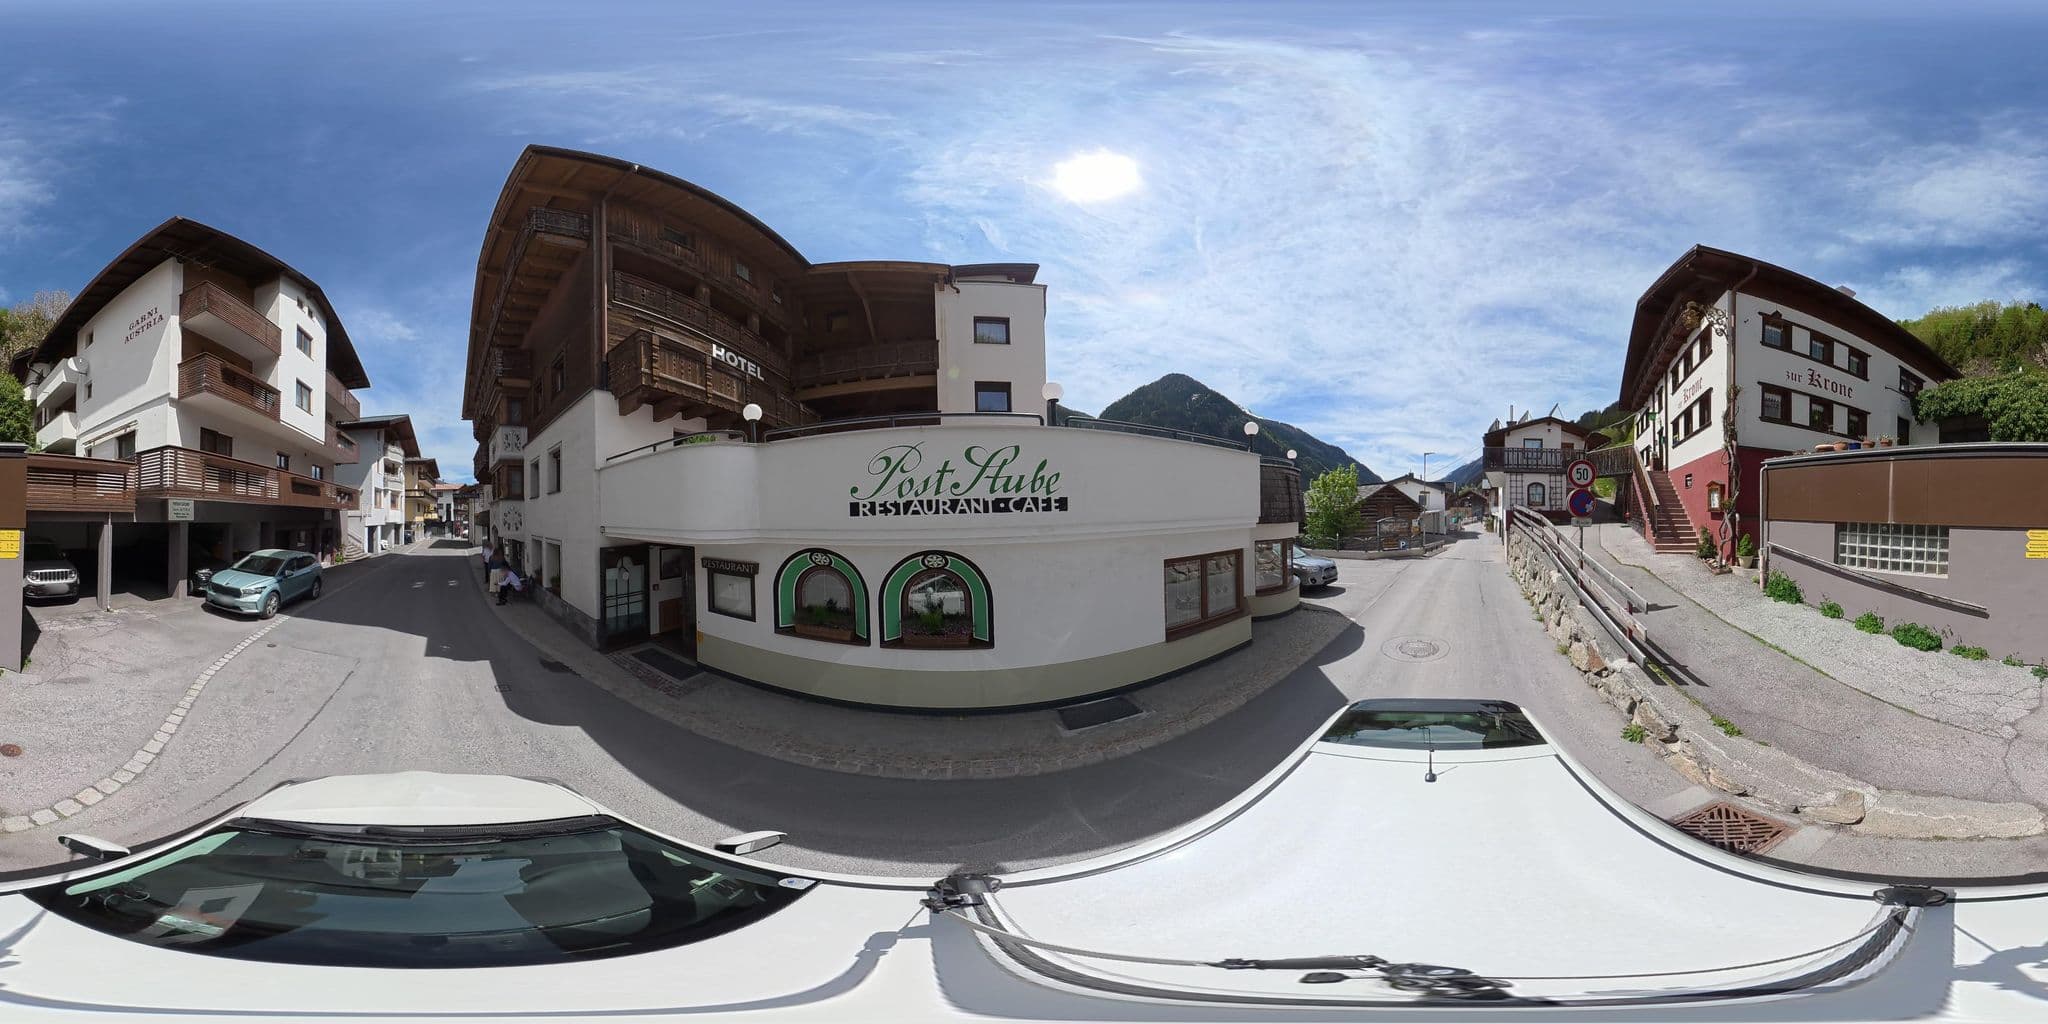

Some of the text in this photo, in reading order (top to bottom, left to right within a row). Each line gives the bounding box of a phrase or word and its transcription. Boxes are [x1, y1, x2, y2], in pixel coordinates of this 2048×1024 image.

[124, 314, 164, 345] AUSTRIA
[129, 307, 158, 331] GARNI
[712, 343, 765, 382] HOTEL
[1786, 368, 1853, 399] zur Krone
[850, 441, 1062, 500] Post Stube
[1576, 468, 1589, 481] 50
[859, 497, 1060, 516] RESTAURANT CAFE
[702, 559, 754, 573] RESTAURANT
